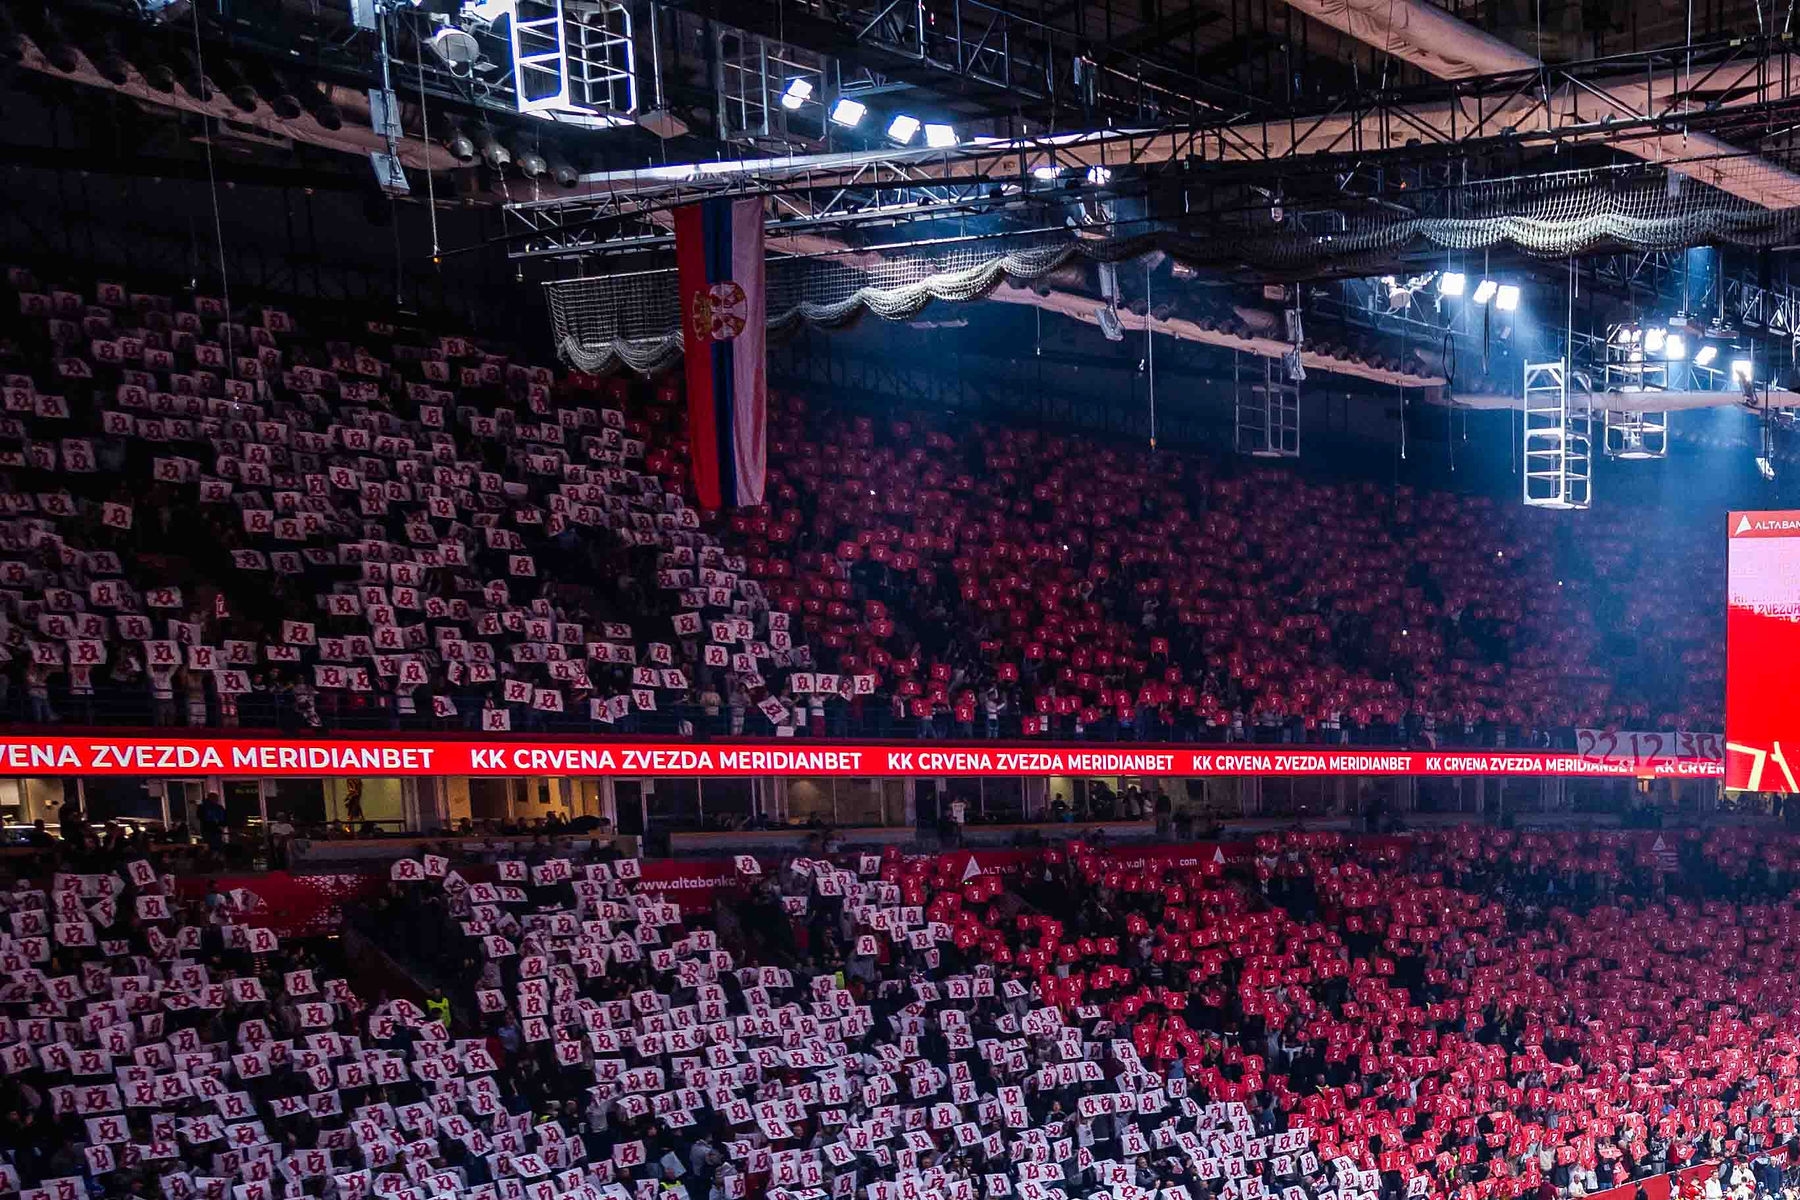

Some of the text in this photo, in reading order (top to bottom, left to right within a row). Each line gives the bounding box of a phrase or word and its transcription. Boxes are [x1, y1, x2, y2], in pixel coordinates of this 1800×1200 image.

[90, 745, 225, 769] ZVEZDA
[232, 747, 435, 770] MERIDIANBET
[470, 749, 862, 771] KK CRVENA ZVEZDA MERIDIANBET
[887, 752, 1175, 771] KK CRVENA ZVEZDA MERIDIANBET
[1192, 755, 1412, 772] KK CRVENA ZVEZDA MERIDIANBET
[1425, 757, 1441, 772] KK
[1443, 757, 1489, 772] CRVENA
[1490, 757, 1542, 772] ZVEZDA
